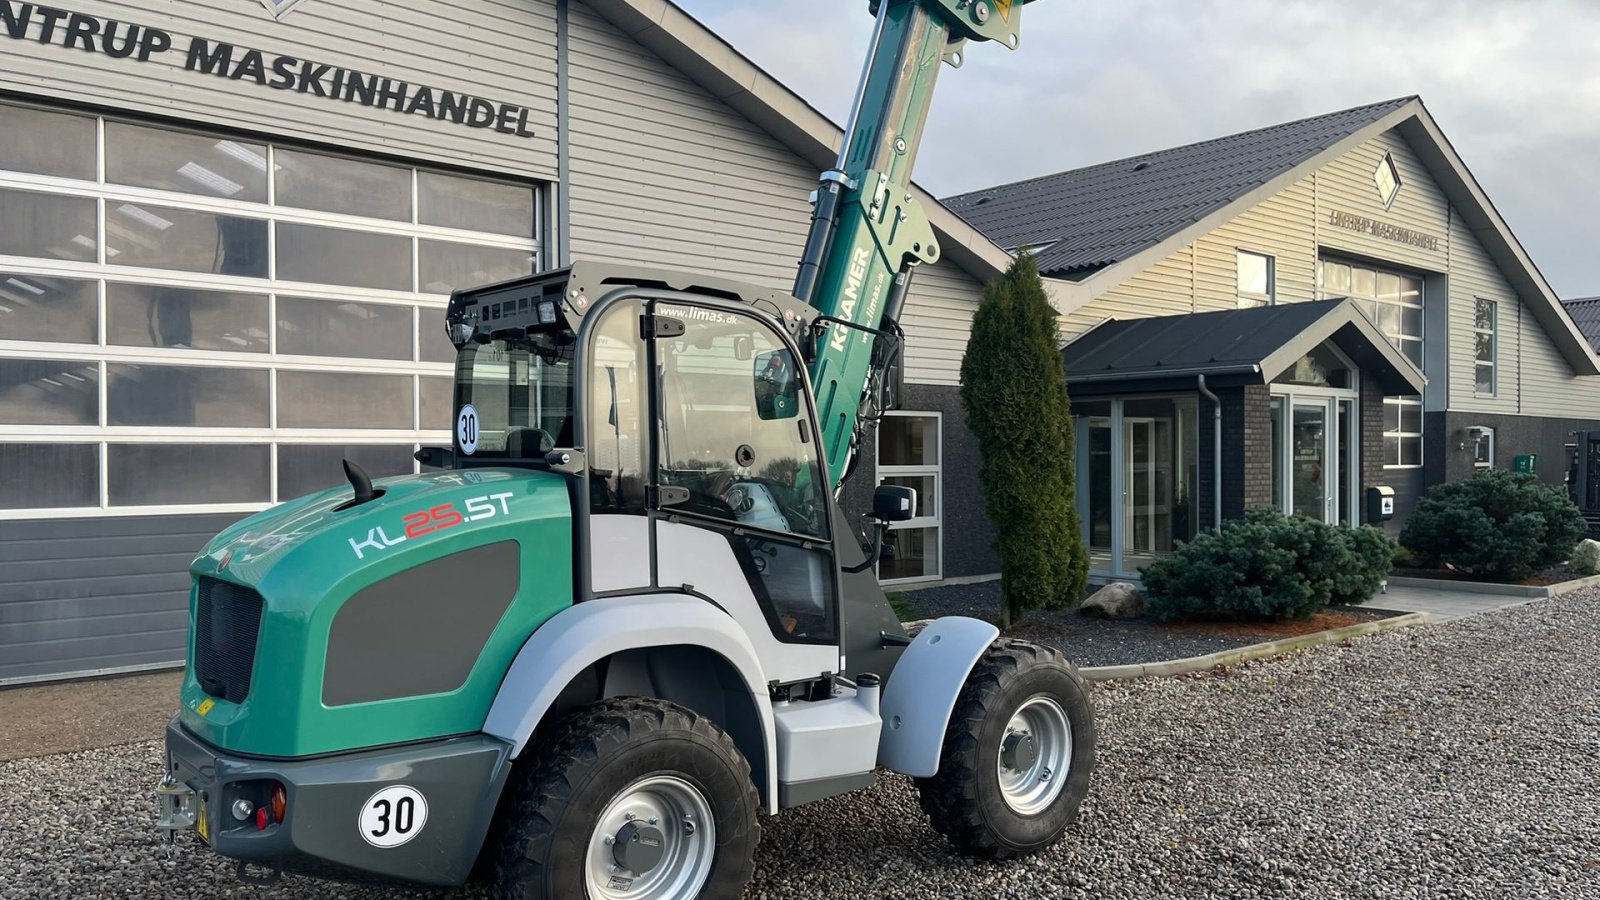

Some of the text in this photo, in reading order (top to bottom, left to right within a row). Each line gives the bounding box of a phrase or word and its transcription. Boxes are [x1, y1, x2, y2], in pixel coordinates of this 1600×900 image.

[184, 37, 536, 138] MASKINHANDEL
[660, 305, 738, 325] www.limas.dk
[830, 247, 870, 353] KRAMER
[460, 413, 476, 445] 30
[348, 491, 514, 560] KL25.5T
[371, 796, 414, 837] 30
